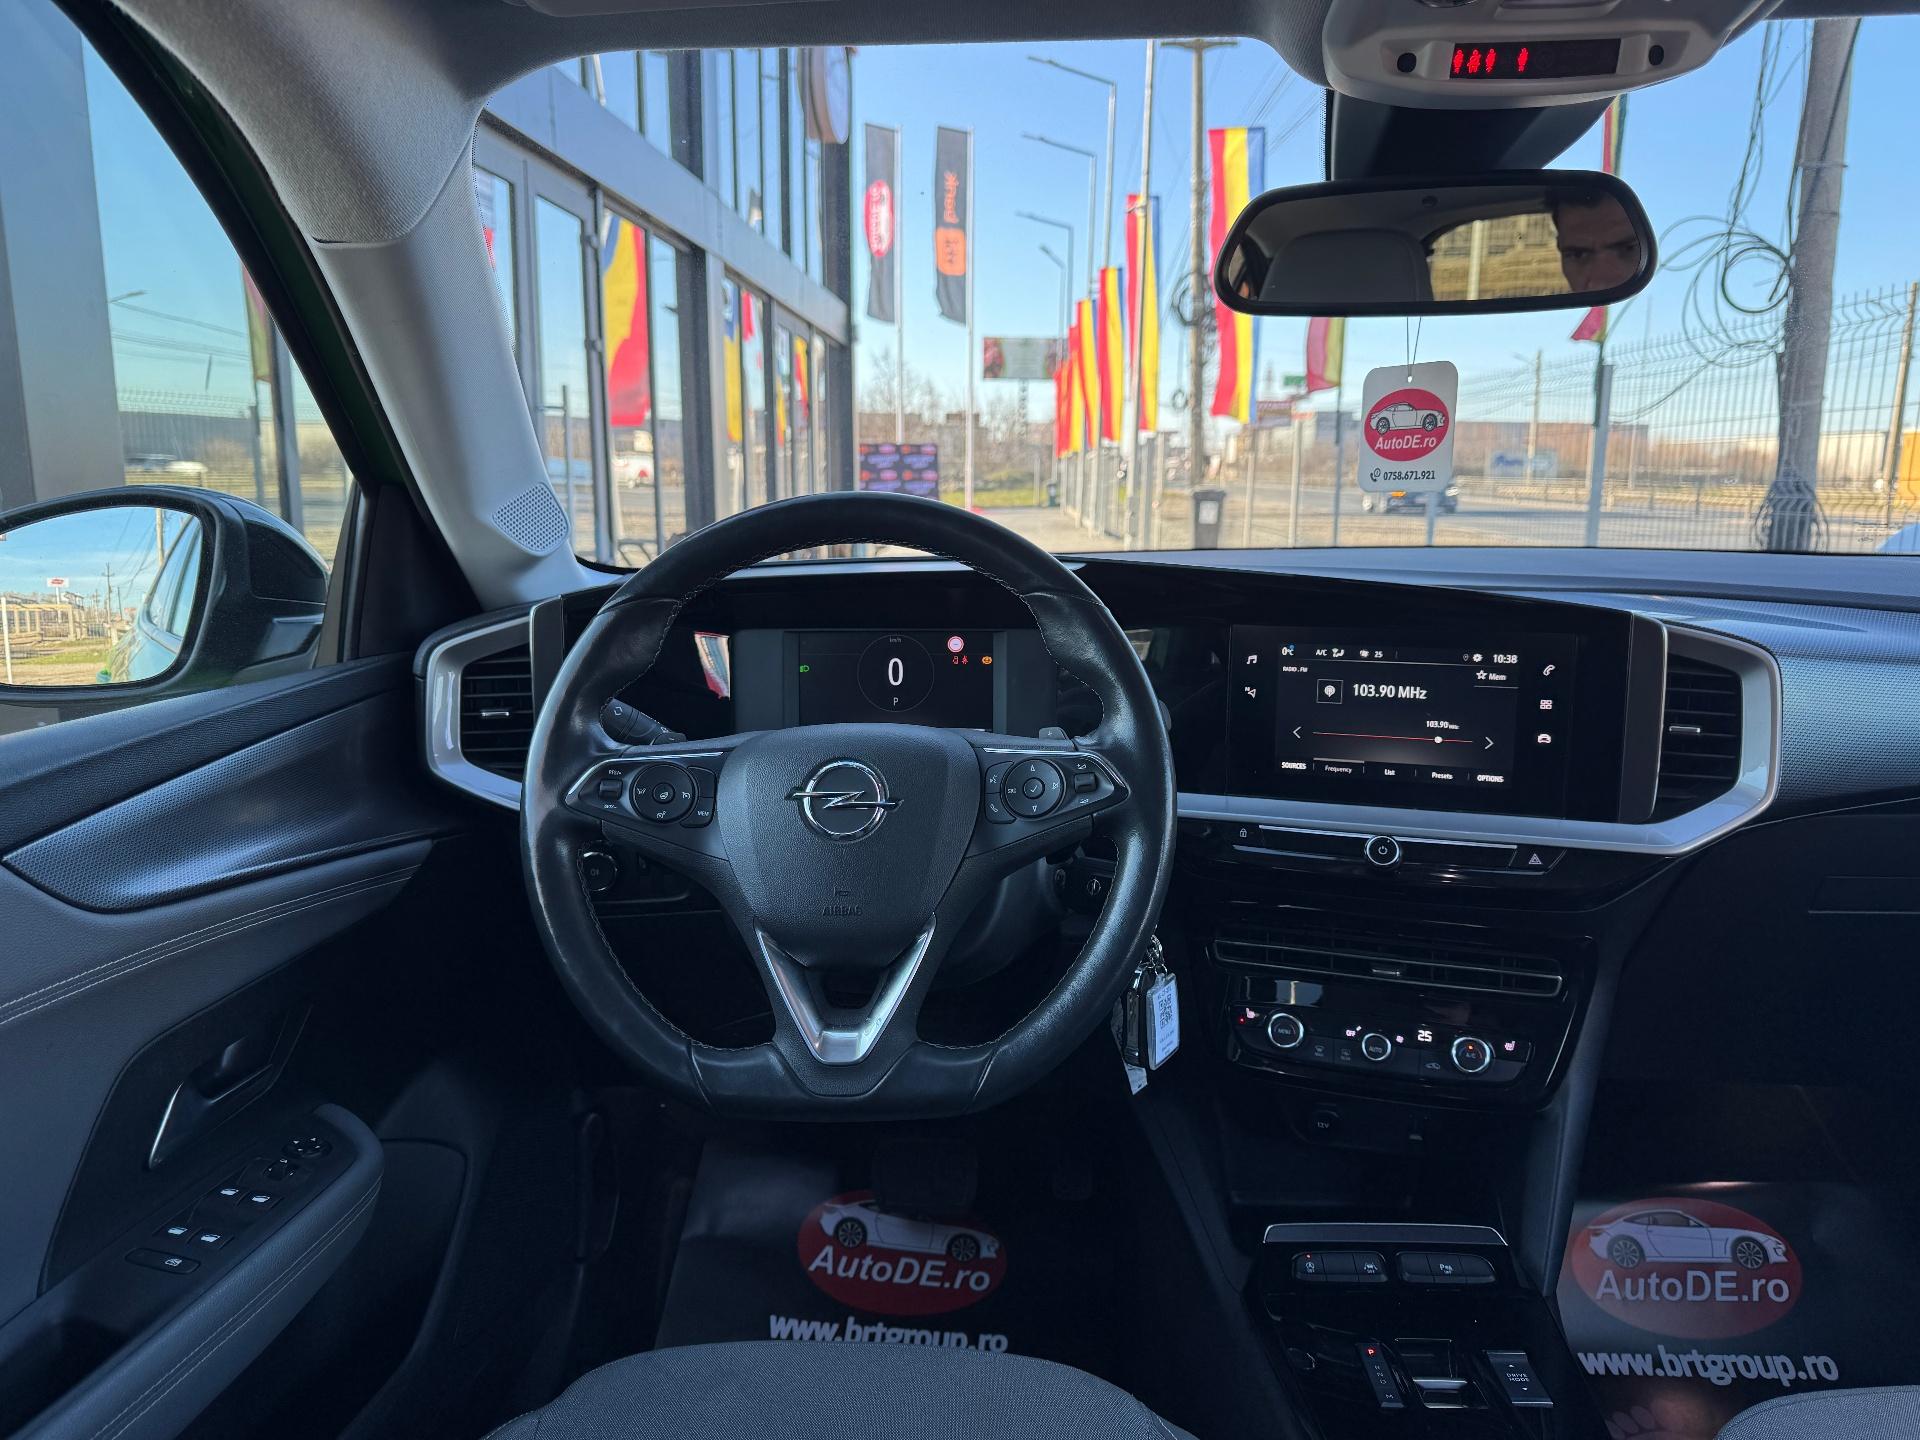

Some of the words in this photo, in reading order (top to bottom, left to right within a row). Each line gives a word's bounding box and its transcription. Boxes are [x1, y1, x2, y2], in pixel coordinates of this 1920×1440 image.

[1374, 435, 1436, 450] AutoDE.ro
[1383, 470, 1436, 481] 0758.671.921
[1315, 648, 1328, 658] A/C
[1492, 653, 1518, 665] 10:38
[887, 657, 904, 687] 0
[1488, 672, 1507, 682] Mem
[1352, 683, 1395, 699] 103.90
[1397, 685, 1428, 701] MHz
[892, 696, 899, 706] P
[1281, 760, 1307, 771] SOURCES
[1324, 764, 1353, 775] Frequency
[1384, 767, 1396, 777] List
[1431, 771, 1454, 781] Presets
[1476, 774, 1505, 784] OPTIONS
[822, 905, 863, 917] AIRBAG
[1417, 1028, 1434, 1043] 25
[808, 1244, 991, 1293] AutoDE.ro
[1595, 1267, 1790, 1304] AutoDE.ro
[1577, 1344, 1839, 1387] www.brtgroup.ro
